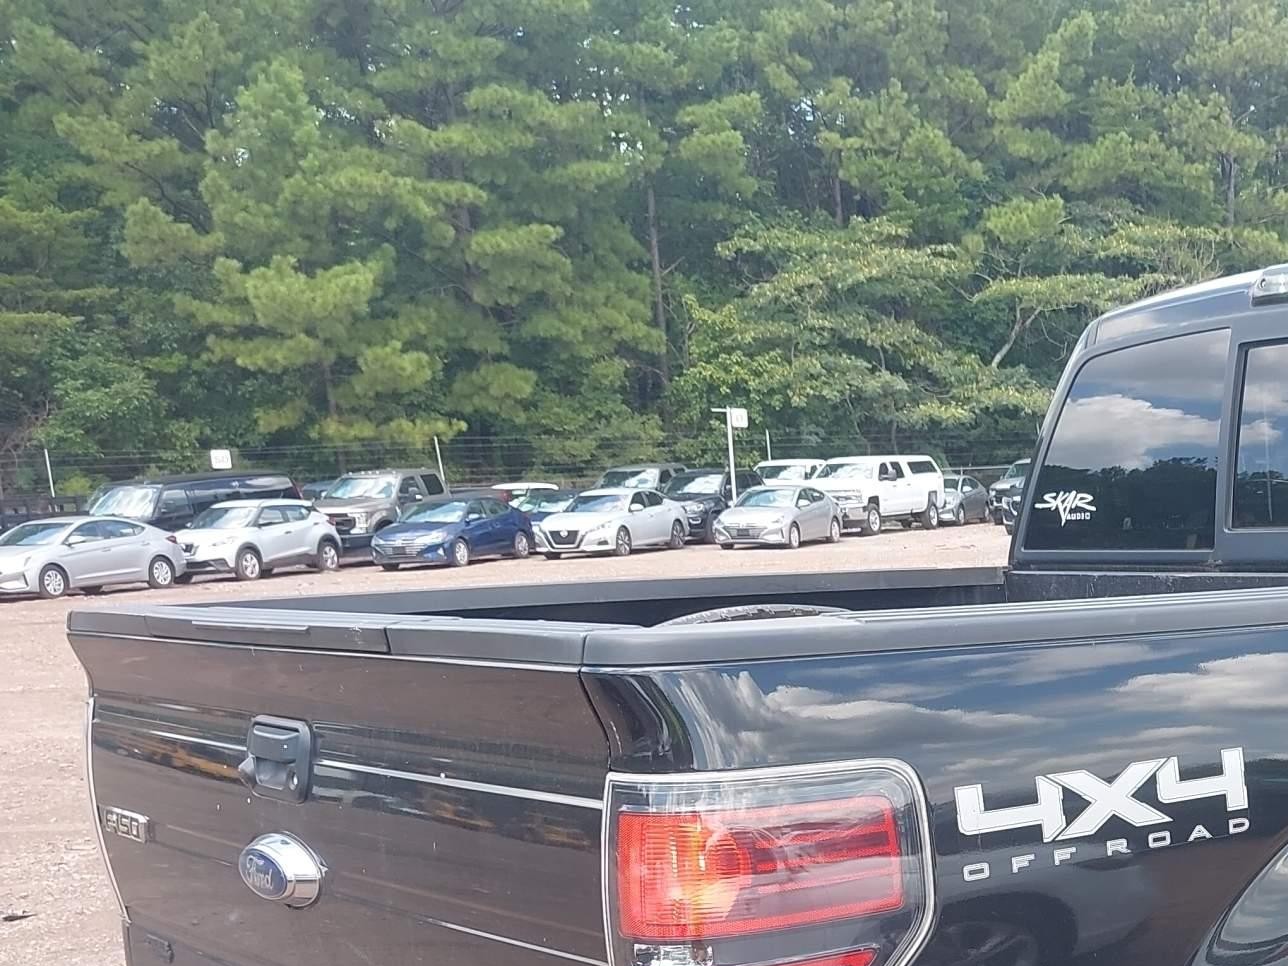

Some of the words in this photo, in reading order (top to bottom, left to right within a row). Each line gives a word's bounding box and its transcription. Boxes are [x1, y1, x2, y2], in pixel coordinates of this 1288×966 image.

[1034, 490, 1097, 527] SKAR
[1066, 512, 1091, 521] AUDIO
[953, 746, 1249, 843] 4X4
[962, 847, 1078, 882] OFF
[1105, 817, 1250, 857] ROAD
[245, 854, 274, 890] Ford
